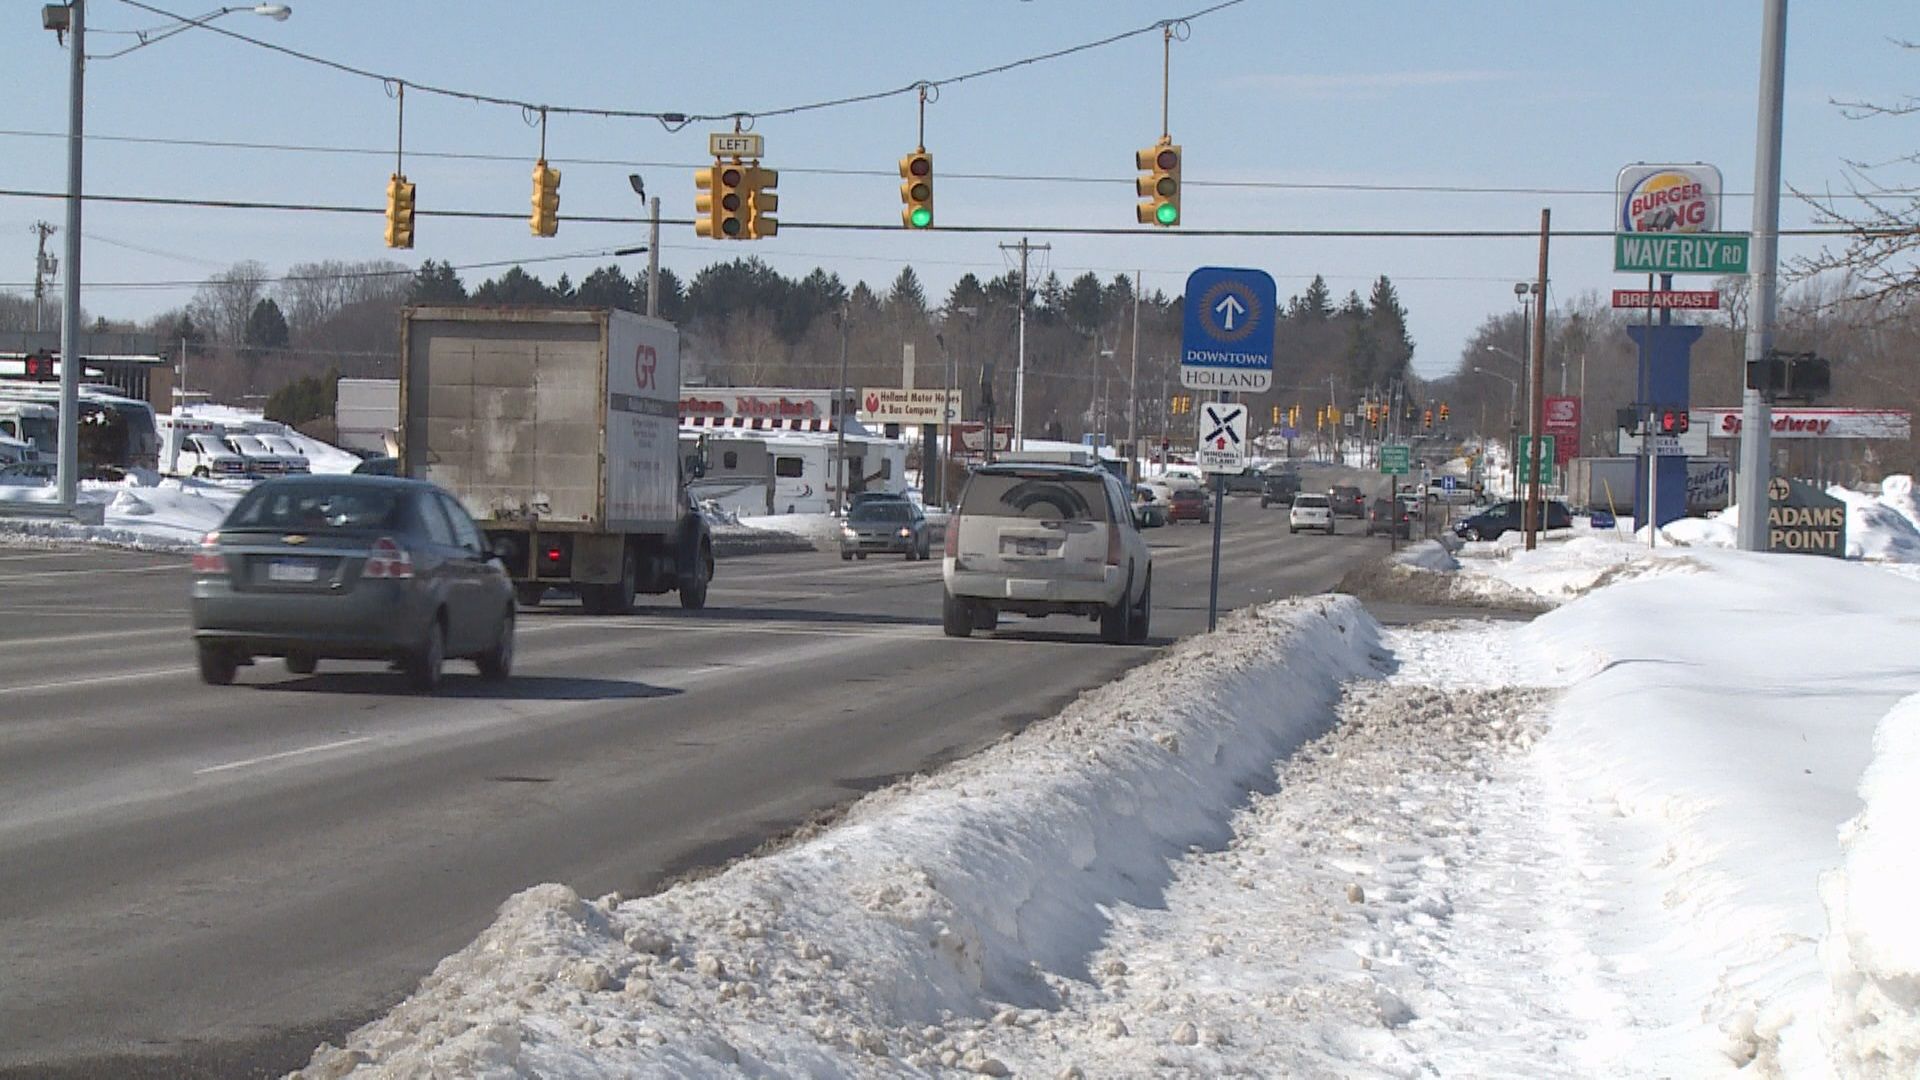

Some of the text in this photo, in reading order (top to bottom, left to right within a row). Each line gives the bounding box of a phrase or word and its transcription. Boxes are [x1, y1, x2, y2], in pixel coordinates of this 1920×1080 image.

[718, 139, 749, 151] LEFT
[1631, 183, 1702, 217] BURGER
[1637, 201, 1706, 232] NG
[1623, 238, 1742, 269] WAVERLY RD
[1619, 292, 1714, 307] BREAKFAST
[1187, 350, 1268, 365] DOWNTOWN
[635, 344, 657, 390] GR
[1186, 371, 1266, 387] HOLLAND
[880, 391, 960, 404] Holland Motor Hoes
[889, 405, 902, 414] Bus
[905, 405, 937, 417] Company
[1721, 414, 1831, 434] Spdway
[1203, 451, 1240, 459] WINDMILL
[1767, 507, 1843, 527] ADAMS
[1770, 531, 1839, 549] POINT
